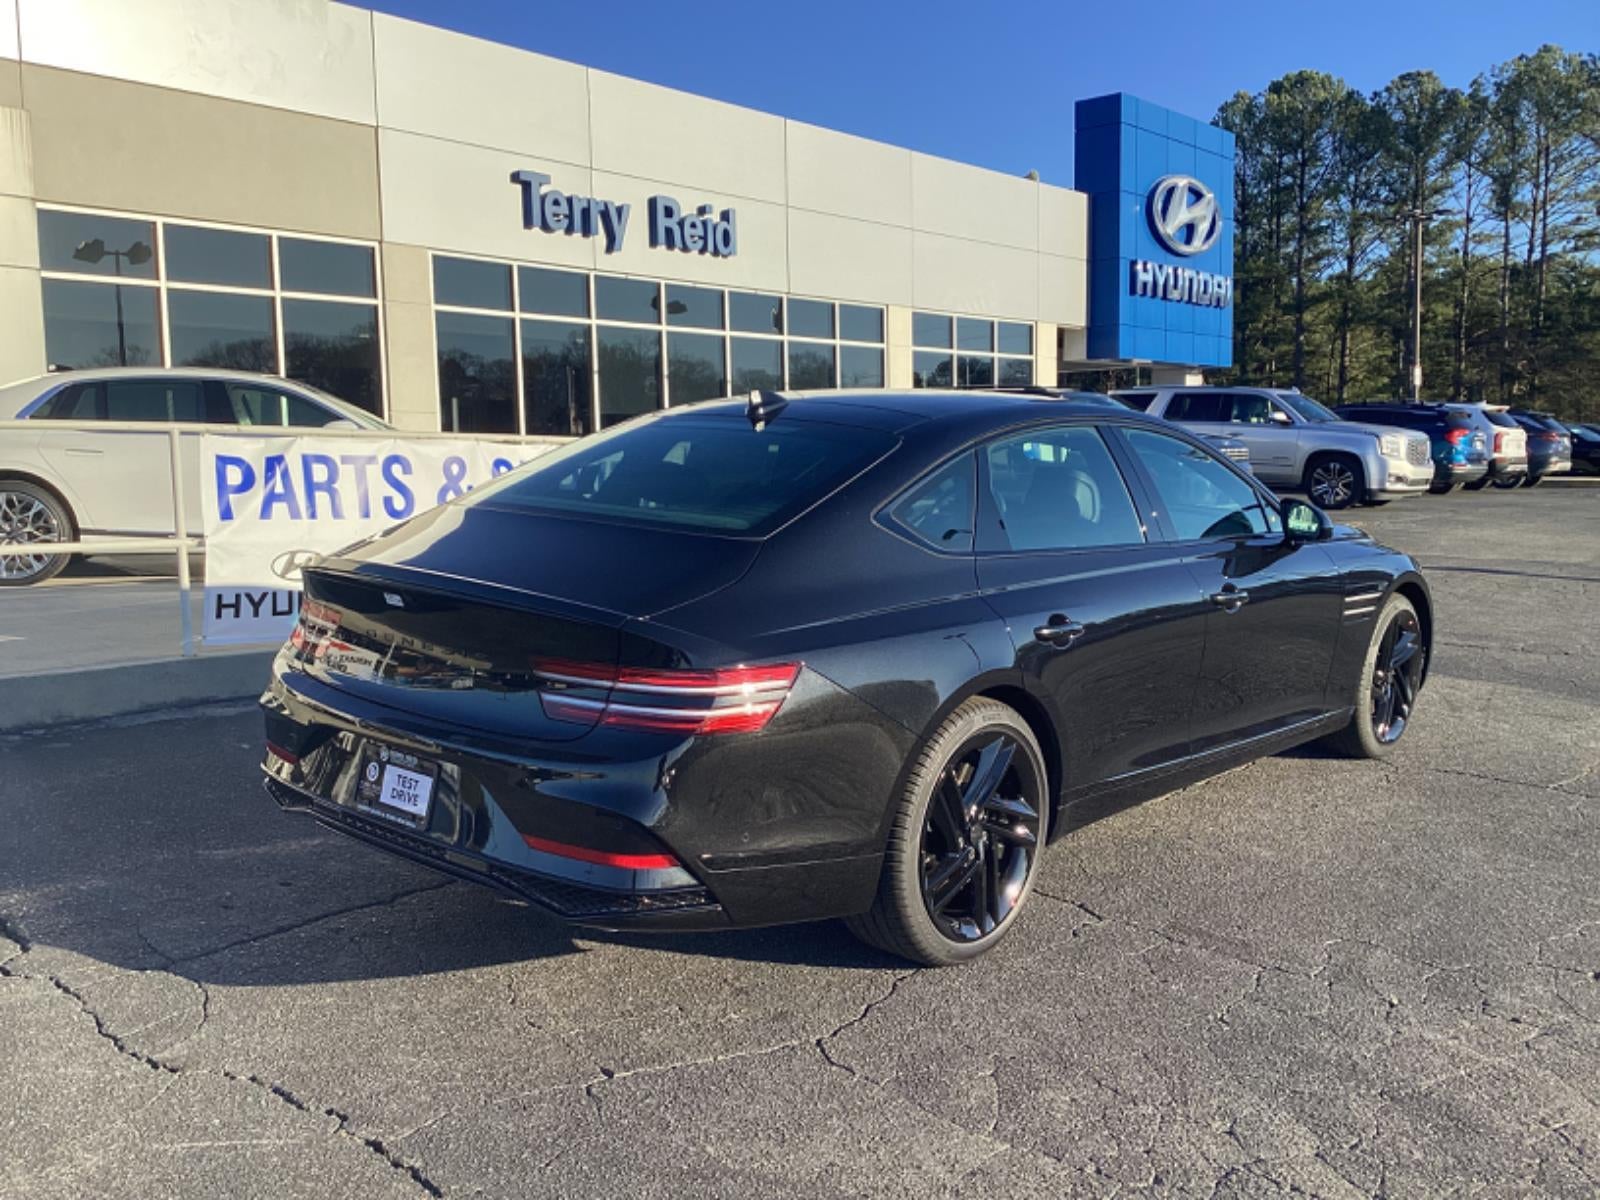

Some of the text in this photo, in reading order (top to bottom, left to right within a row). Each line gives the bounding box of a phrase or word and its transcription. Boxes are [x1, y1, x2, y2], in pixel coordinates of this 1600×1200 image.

[510, 169, 737, 258] Terry Reid
[1129, 259, 1232, 309] HYUNDAI
[215, 453, 473, 521] PARTS &
[215, 590, 303, 619] HYU
[390, 786, 420, 807] DRIVE
[396, 774, 420, 791] TEST
